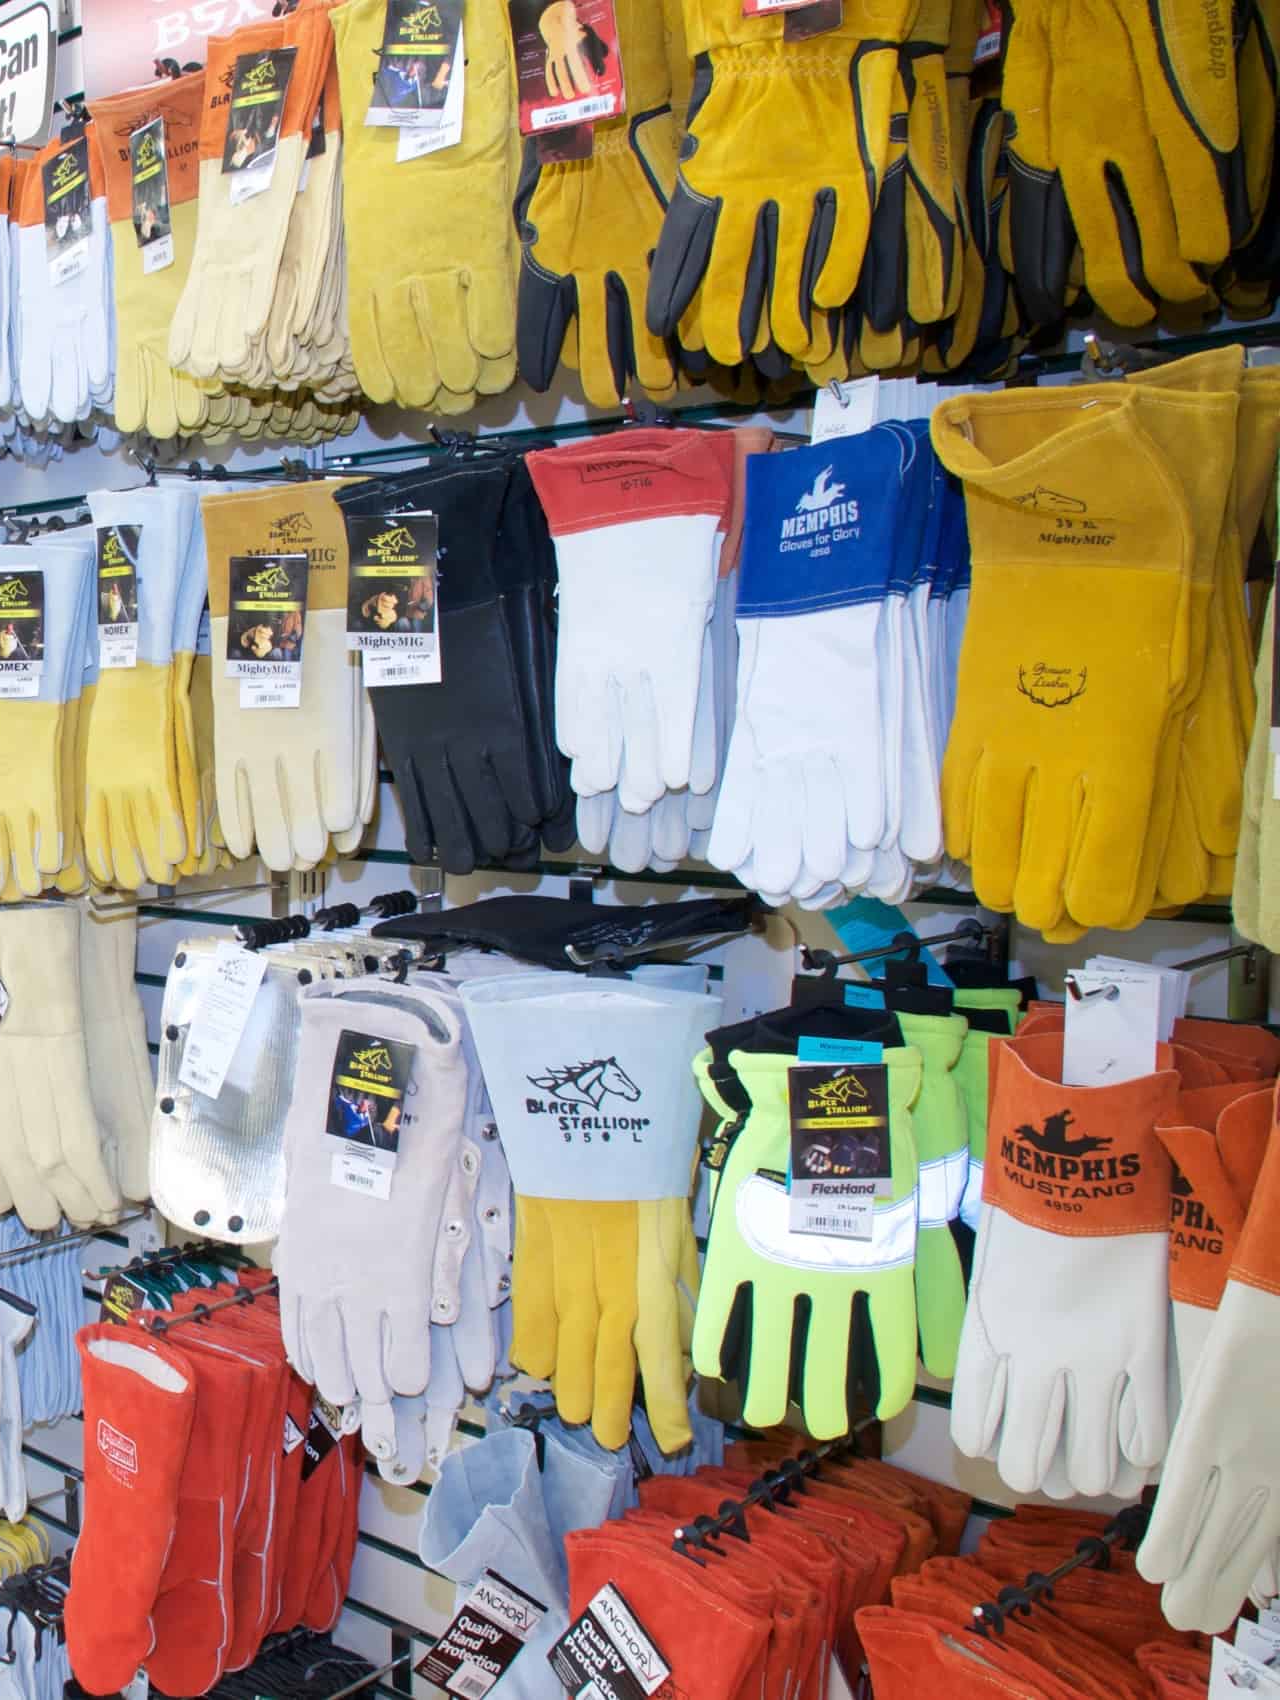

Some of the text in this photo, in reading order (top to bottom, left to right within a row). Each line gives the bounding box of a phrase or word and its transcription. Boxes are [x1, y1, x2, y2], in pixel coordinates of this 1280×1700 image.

[210, 93, 231, 109] BLA
[167, 141, 199, 160] LLION
[781, 500, 859, 539] MEMPHIS
[779, 526, 860, 553] Gloves for Glory
[103, 625, 129, 636] NOMEX
[357, 635, 424, 649] MightyMIG
[237, 662, 292, 675] MightyMIG
[526, 1098, 580, 1114] BLACK
[808, 1100, 838, 1109] BLACK
[826, 1106, 869, 1116] STALLION
[1001, 1136, 1141, 1182] MEMPHIS
[811, 1182, 876, 1196] FlexHand
[1004, 1166, 1136, 1200] MUSTANG
[475, 1586, 524, 1627] ANCHOR
[448, 1630, 484, 1651] Hand
[457, 1615, 504, 1645] Quality
[597, 1599, 650, 1668] ANCHOR
[437, 1641, 502, 1675] Protection
[572, 1627, 607, 1670] Hand
[580, 1618, 626, 1675] Quality
[564, 1634, 618, 1700] Protectio
